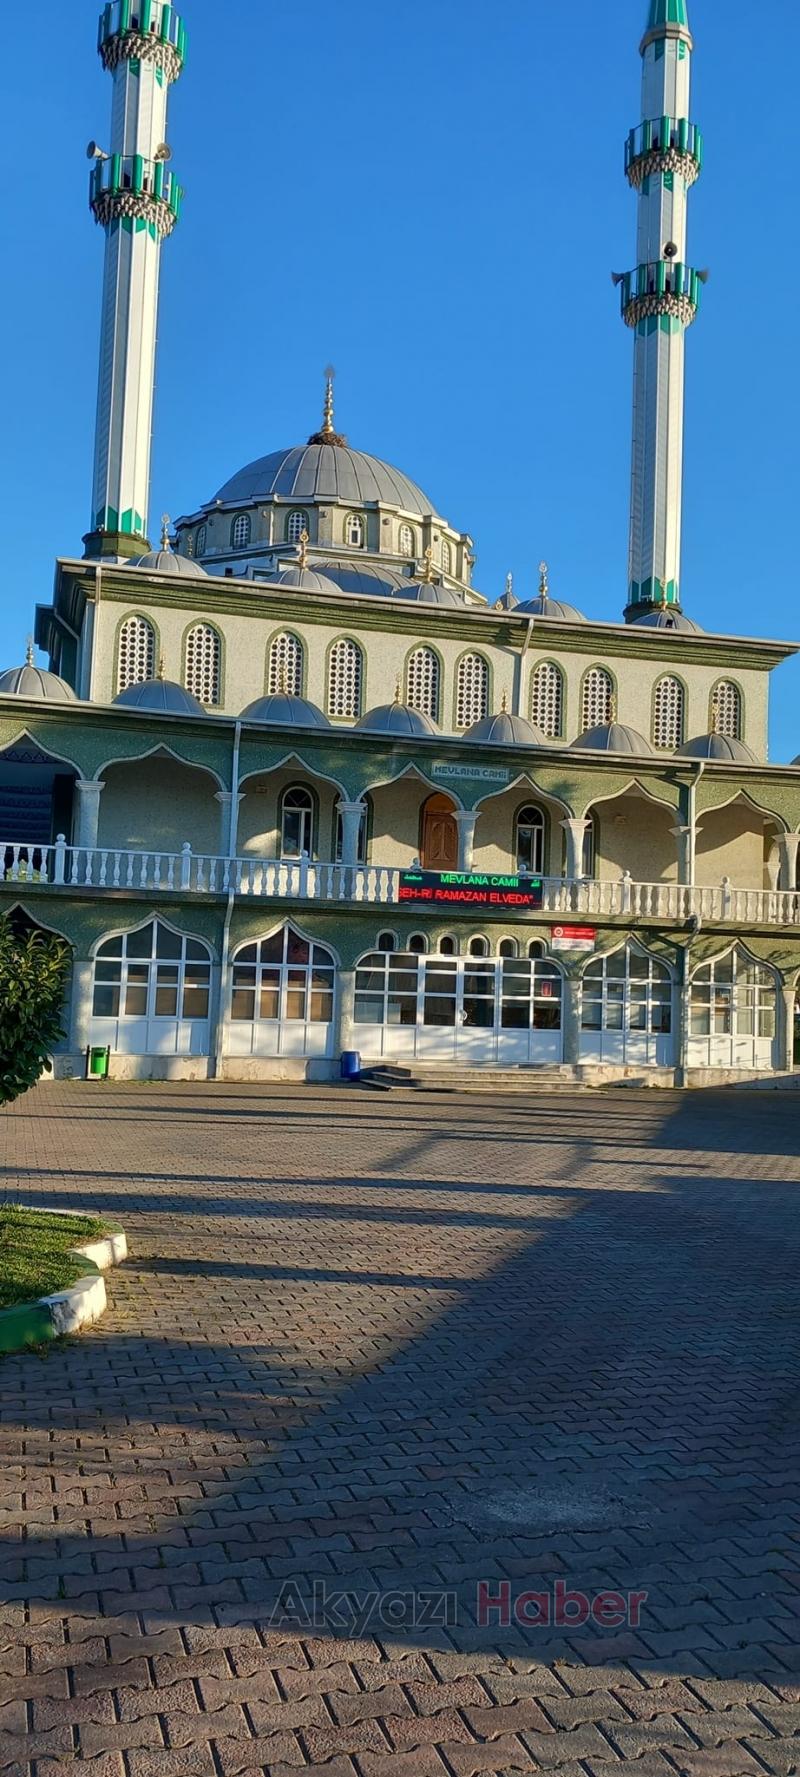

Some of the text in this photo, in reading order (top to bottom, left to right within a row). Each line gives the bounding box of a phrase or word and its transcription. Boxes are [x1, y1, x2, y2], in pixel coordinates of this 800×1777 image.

[434, 765, 480, 777] MEVLANA
[440, 873, 489, 886] MEVLANA
[435, 889, 487, 902] RAMAZAN
